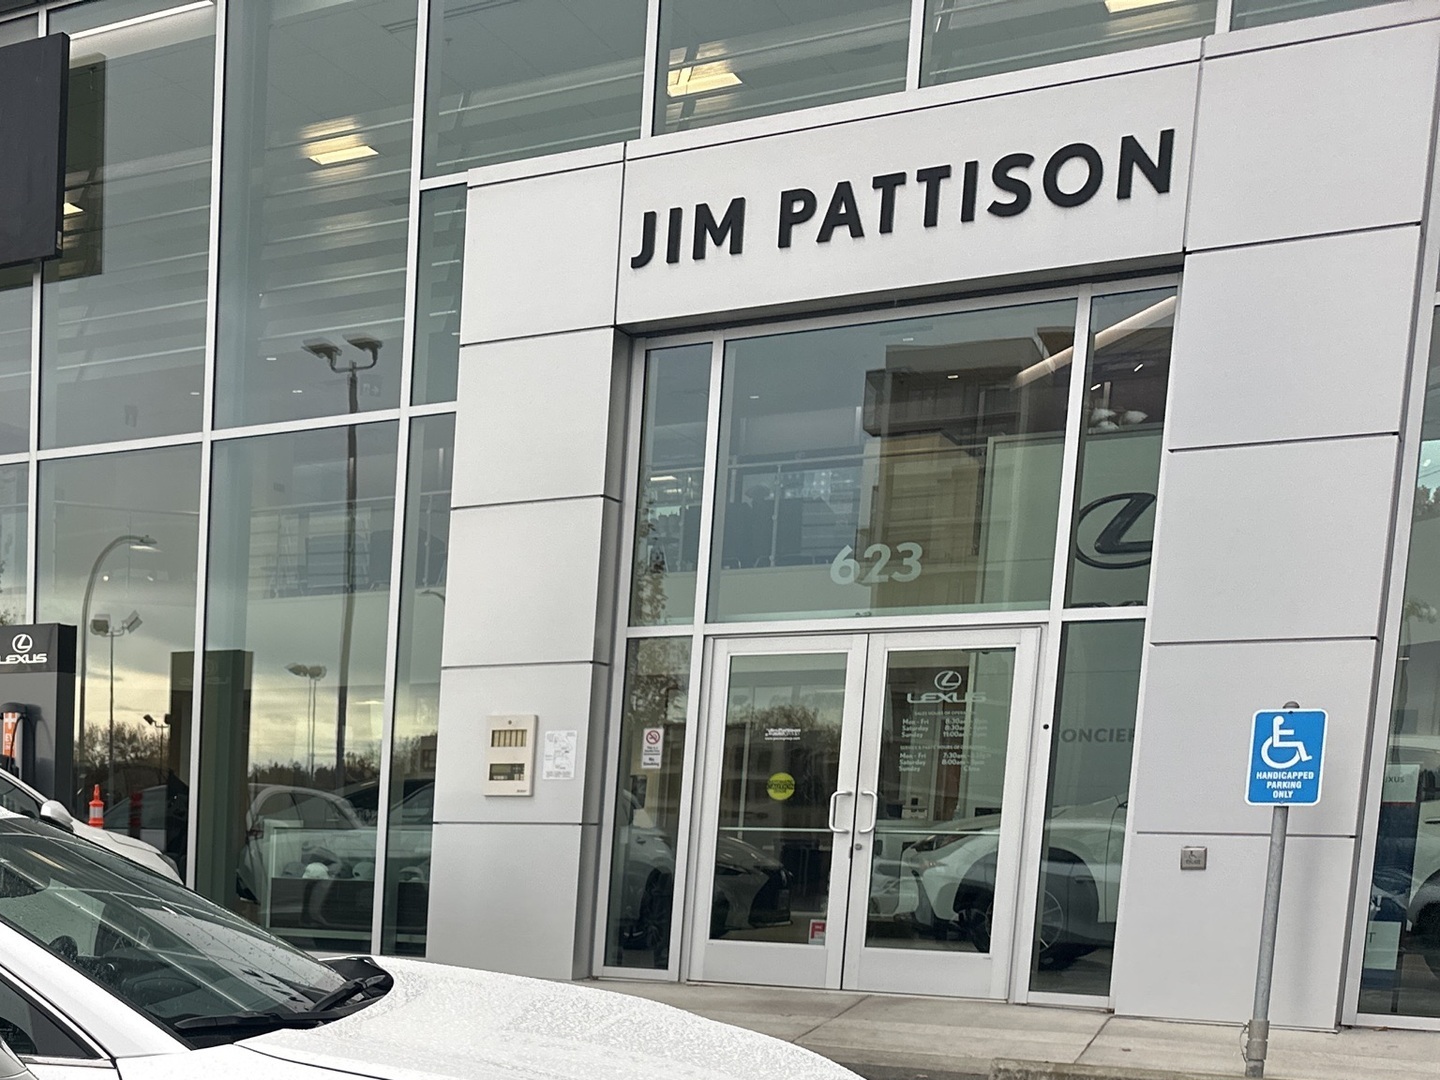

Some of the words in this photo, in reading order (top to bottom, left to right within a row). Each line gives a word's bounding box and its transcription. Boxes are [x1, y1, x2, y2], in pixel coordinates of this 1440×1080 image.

[631, 197, 745, 269] JIM
[778, 129, 1175, 250] PATTISON
[830, 542, 923, 585] 623
[906, 692, 987, 704] LEXUS
[1256, 771, 1315, 780] HANDICAPPED
[1266, 781, 1302, 789] PARKING
[1272, 790, 1294, 799] ONLY
